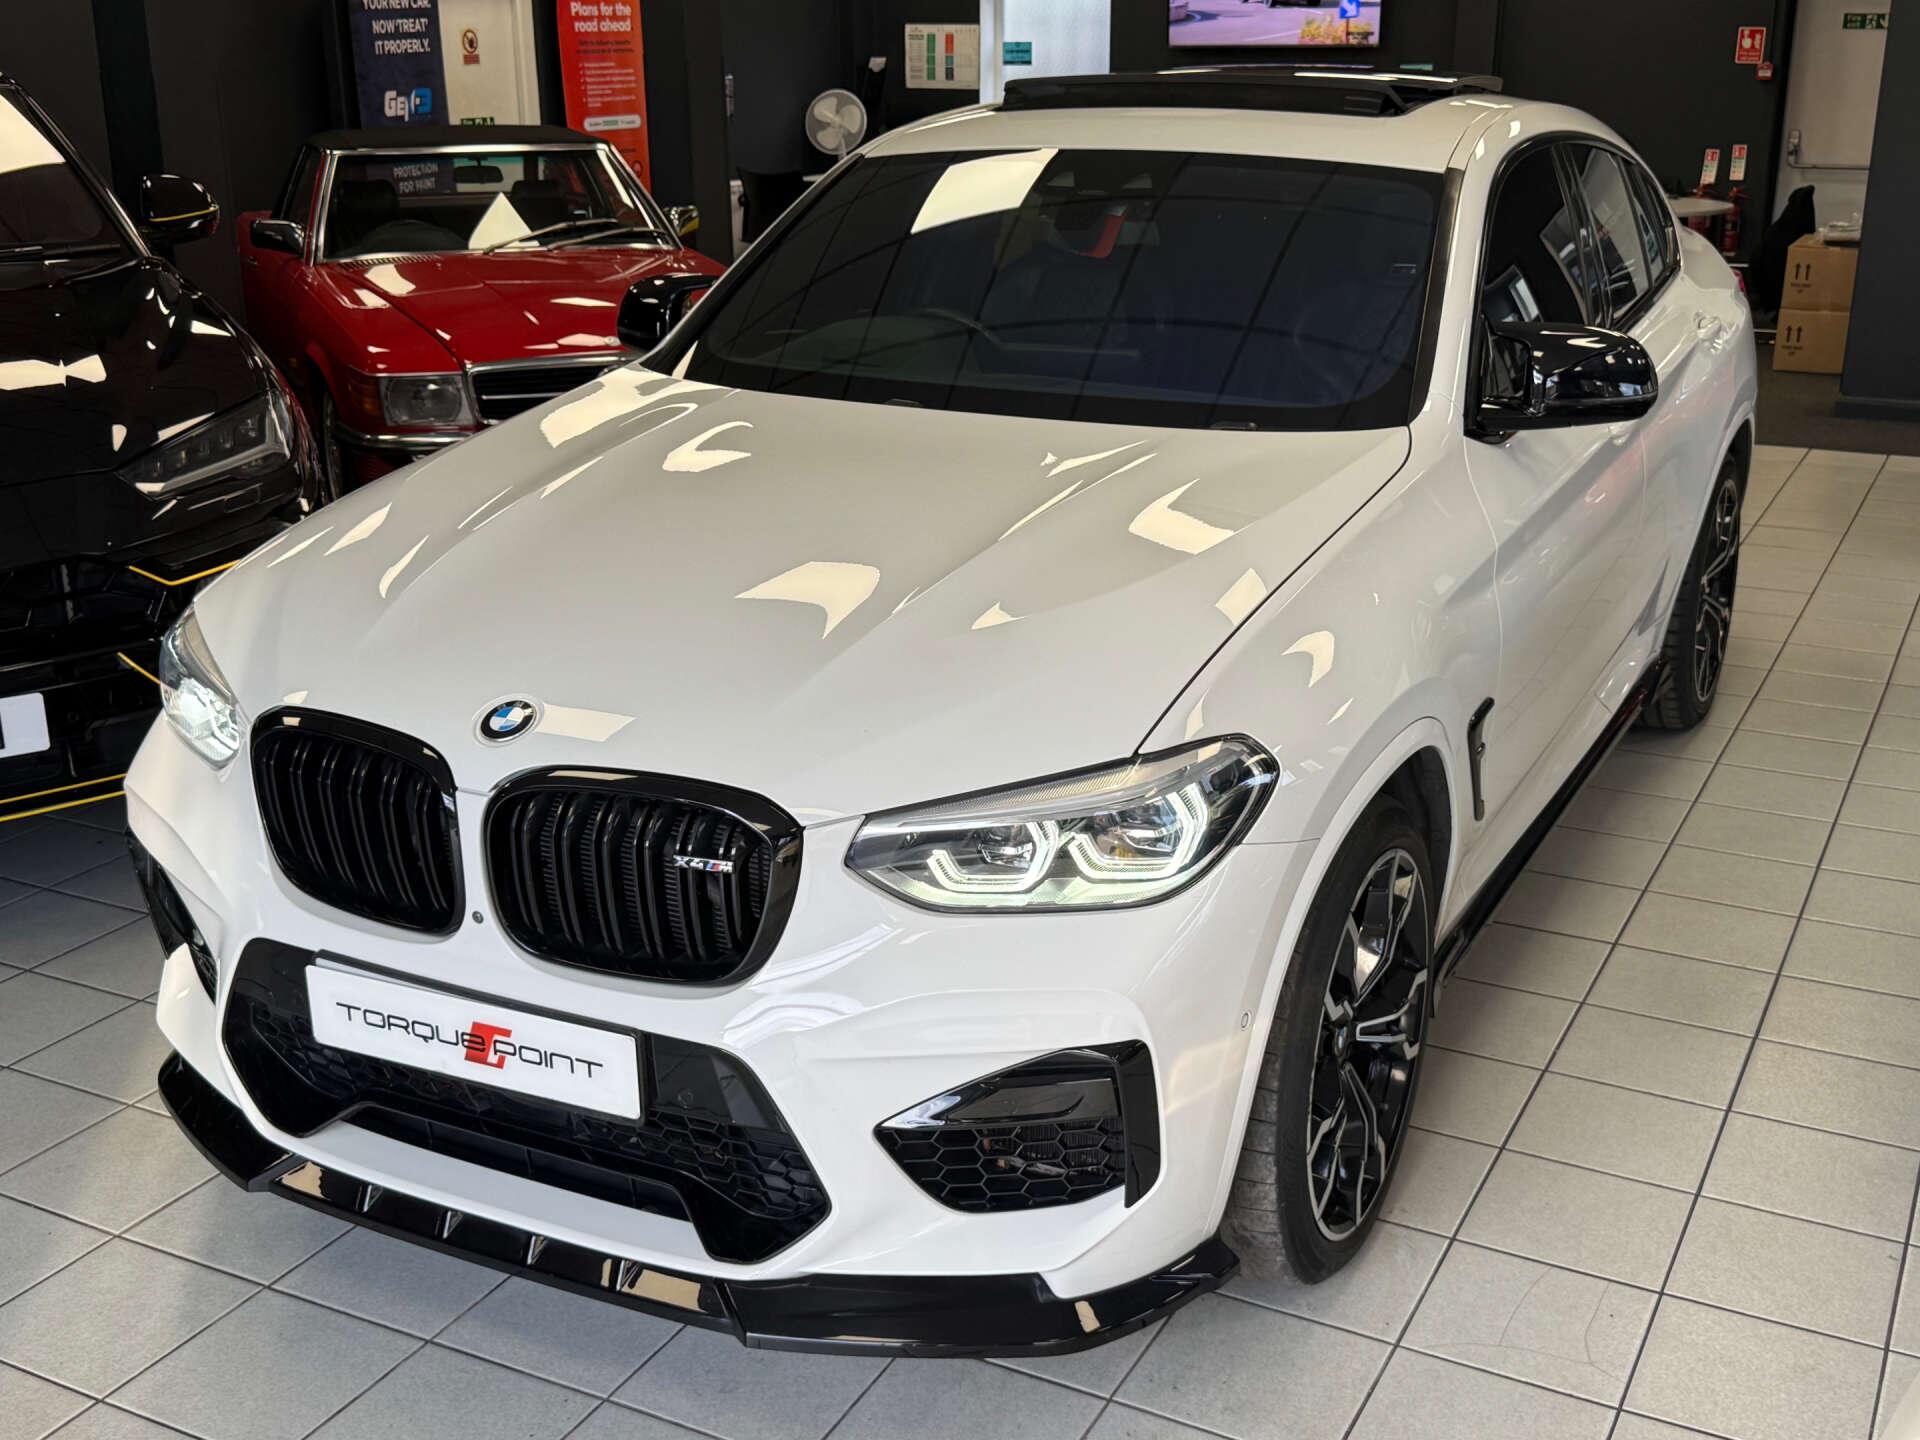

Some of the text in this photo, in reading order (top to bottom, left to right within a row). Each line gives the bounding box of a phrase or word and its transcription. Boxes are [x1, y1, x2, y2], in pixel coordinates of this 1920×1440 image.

[363, 0, 388, 10] YOUR
[389, 0, 409, 9] NEW
[570, 2, 631, 16] Plans for the
[372, 20, 395, 34] NOW
[574, 18, 631, 32] road ahead
[375, 39, 430, 55] IT PROPERLY.
[400, 180, 415, 193] FOR
[336, 1002, 604, 1078] TORQUE POINT
